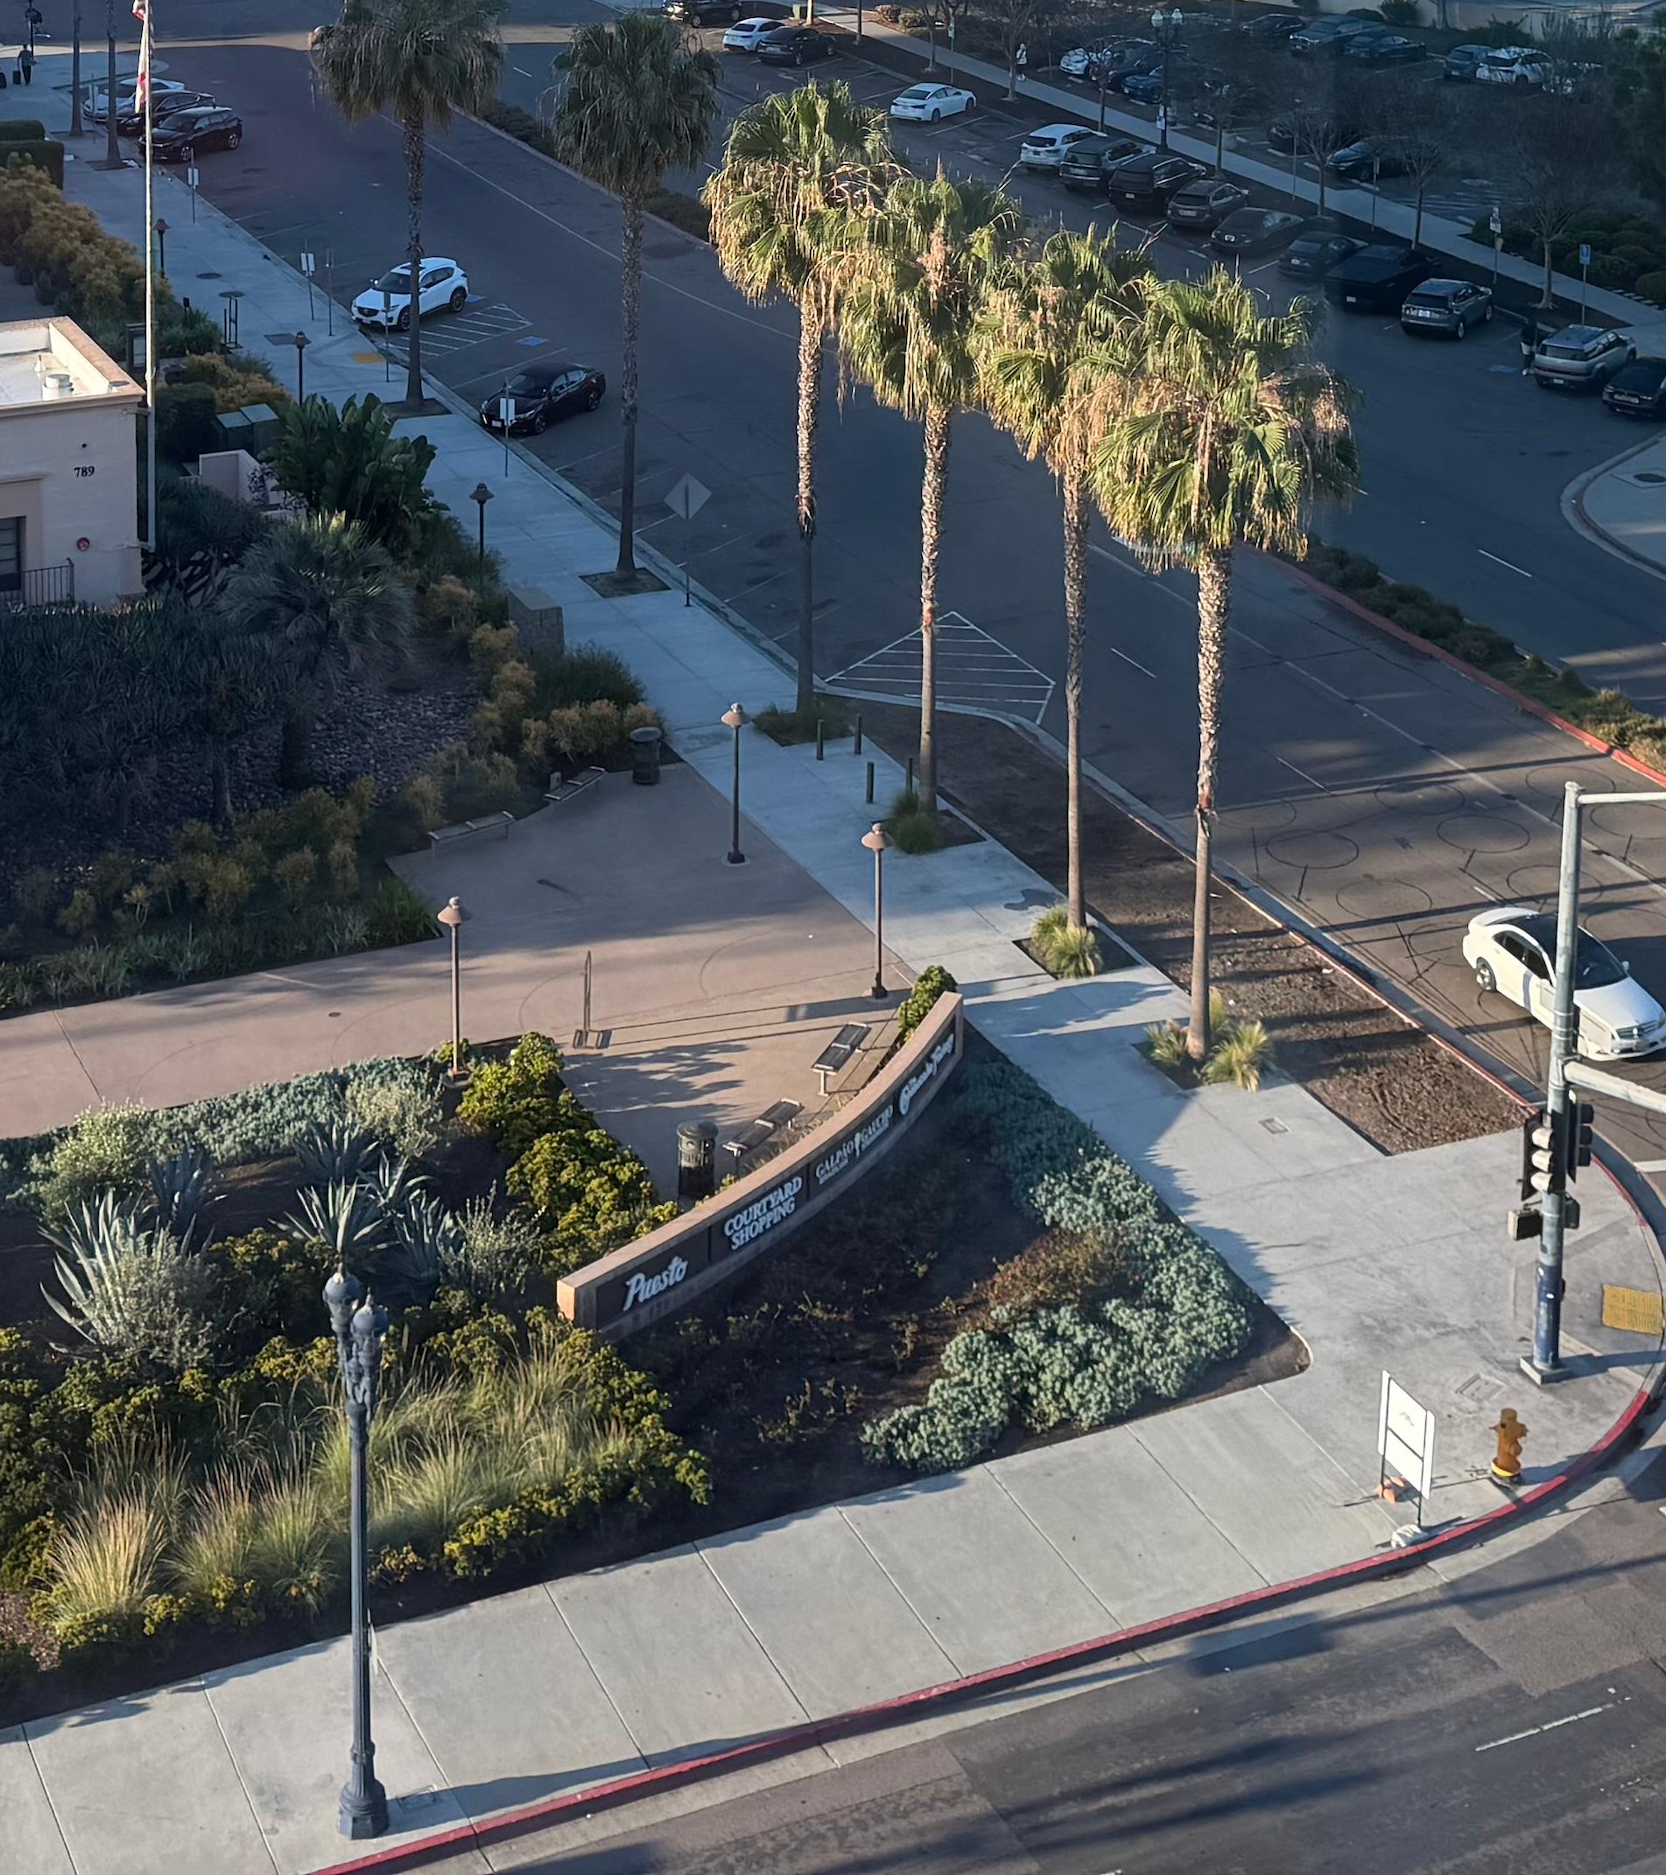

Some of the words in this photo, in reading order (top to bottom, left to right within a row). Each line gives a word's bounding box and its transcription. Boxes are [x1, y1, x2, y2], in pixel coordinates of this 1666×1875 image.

[74, 465, 95, 478] 789
[724, 1176, 803, 1237] COURTYARD
[731, 1196, 796, 1251] SHOPPING
[622, 1256, 689, 1312] Puesto
